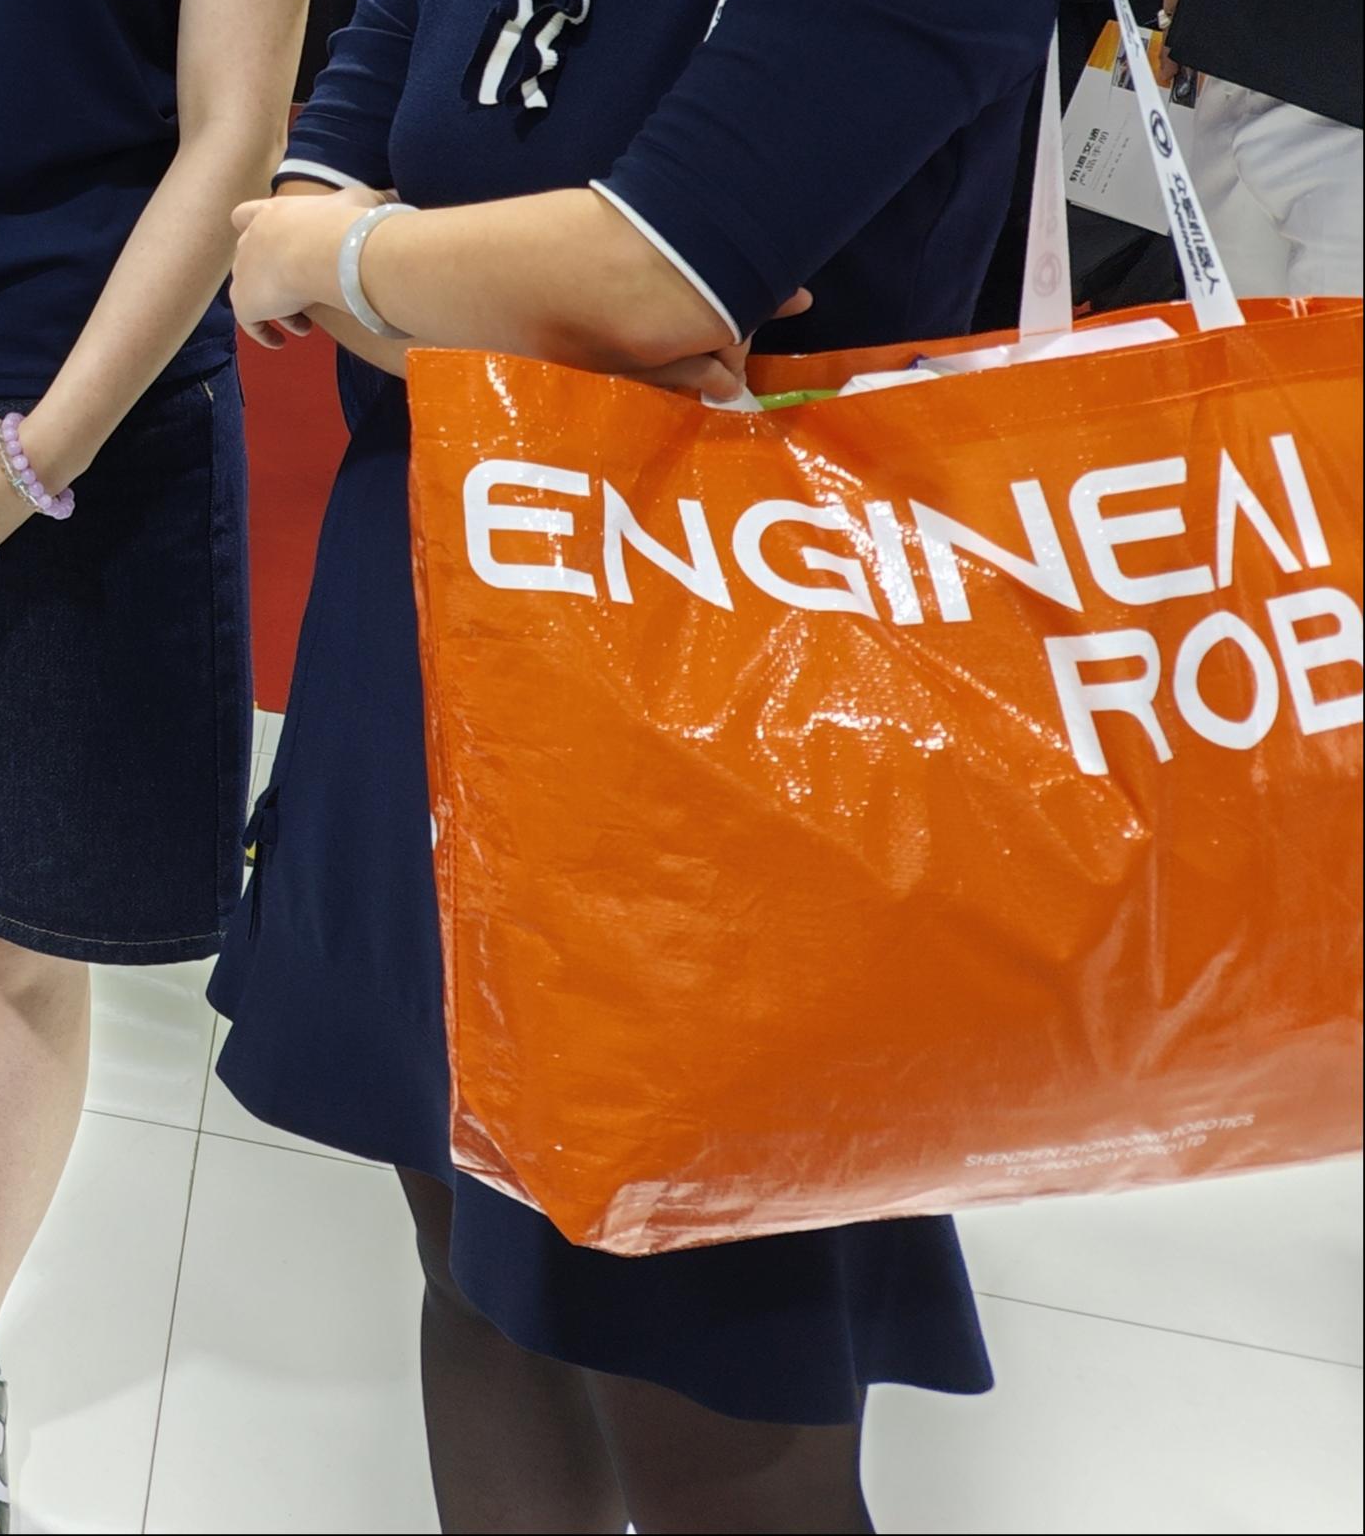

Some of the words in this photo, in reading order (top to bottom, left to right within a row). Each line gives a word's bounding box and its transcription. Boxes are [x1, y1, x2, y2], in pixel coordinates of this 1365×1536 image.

[463, 434, 1333, 626] ENGINEAI
[1045, 586, 1363, 776] ROB
[964, 1147, 1060, 1168] SHENZHEN
[1171, 1113, 1256, 1138] ROBOTICS
